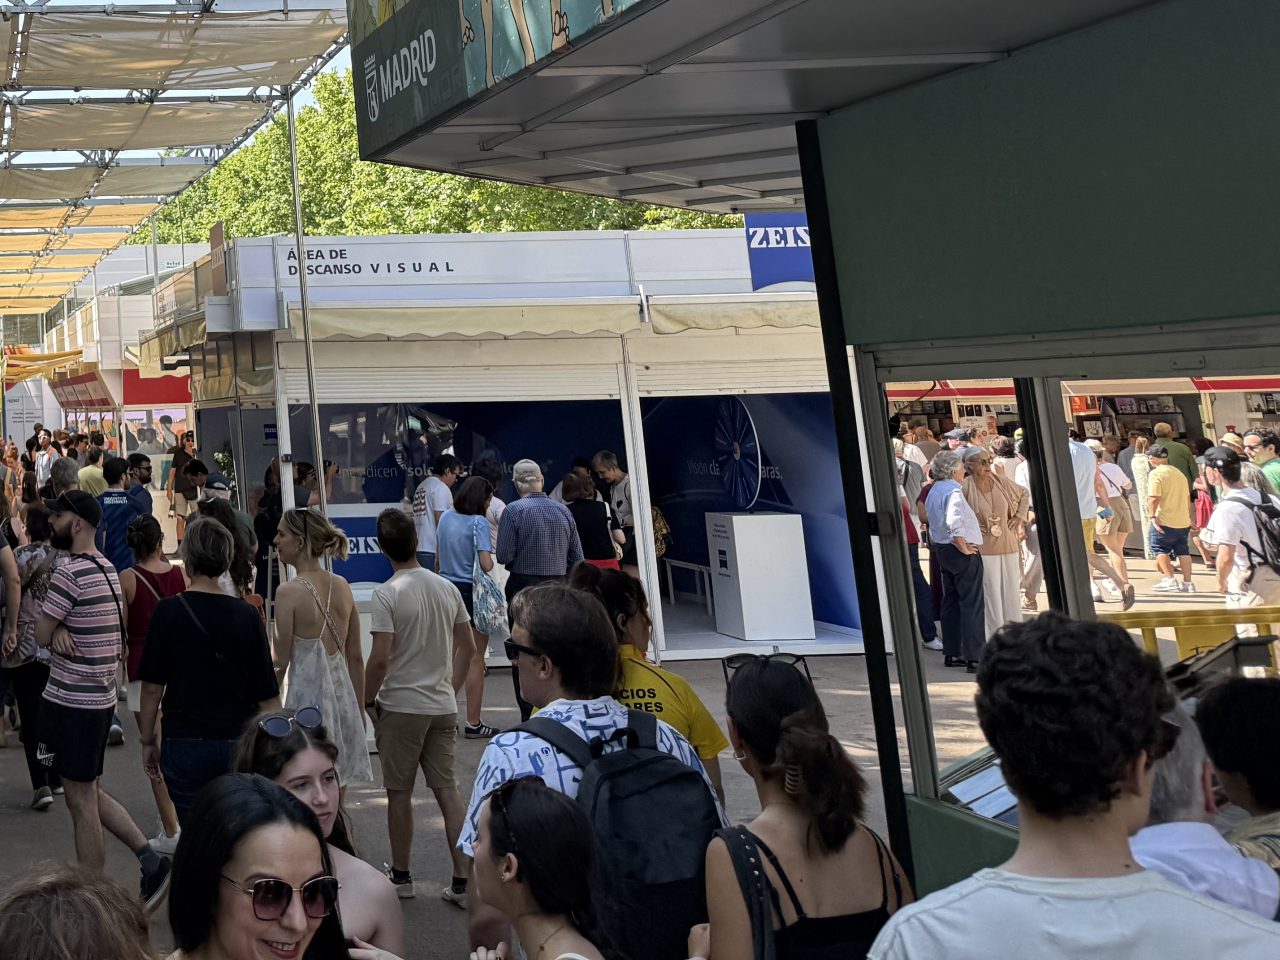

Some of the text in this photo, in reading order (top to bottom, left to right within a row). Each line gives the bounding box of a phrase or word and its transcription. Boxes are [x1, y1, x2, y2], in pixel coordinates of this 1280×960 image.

[380, 28, 437, 104] MADRID
[749, 226, 811, 249] ZEIS
[286, 247, 348, 260] ÁEA DE
[288, 263, 362, 276] DSCANSO
[620, 687, 657, 700] CIOS
